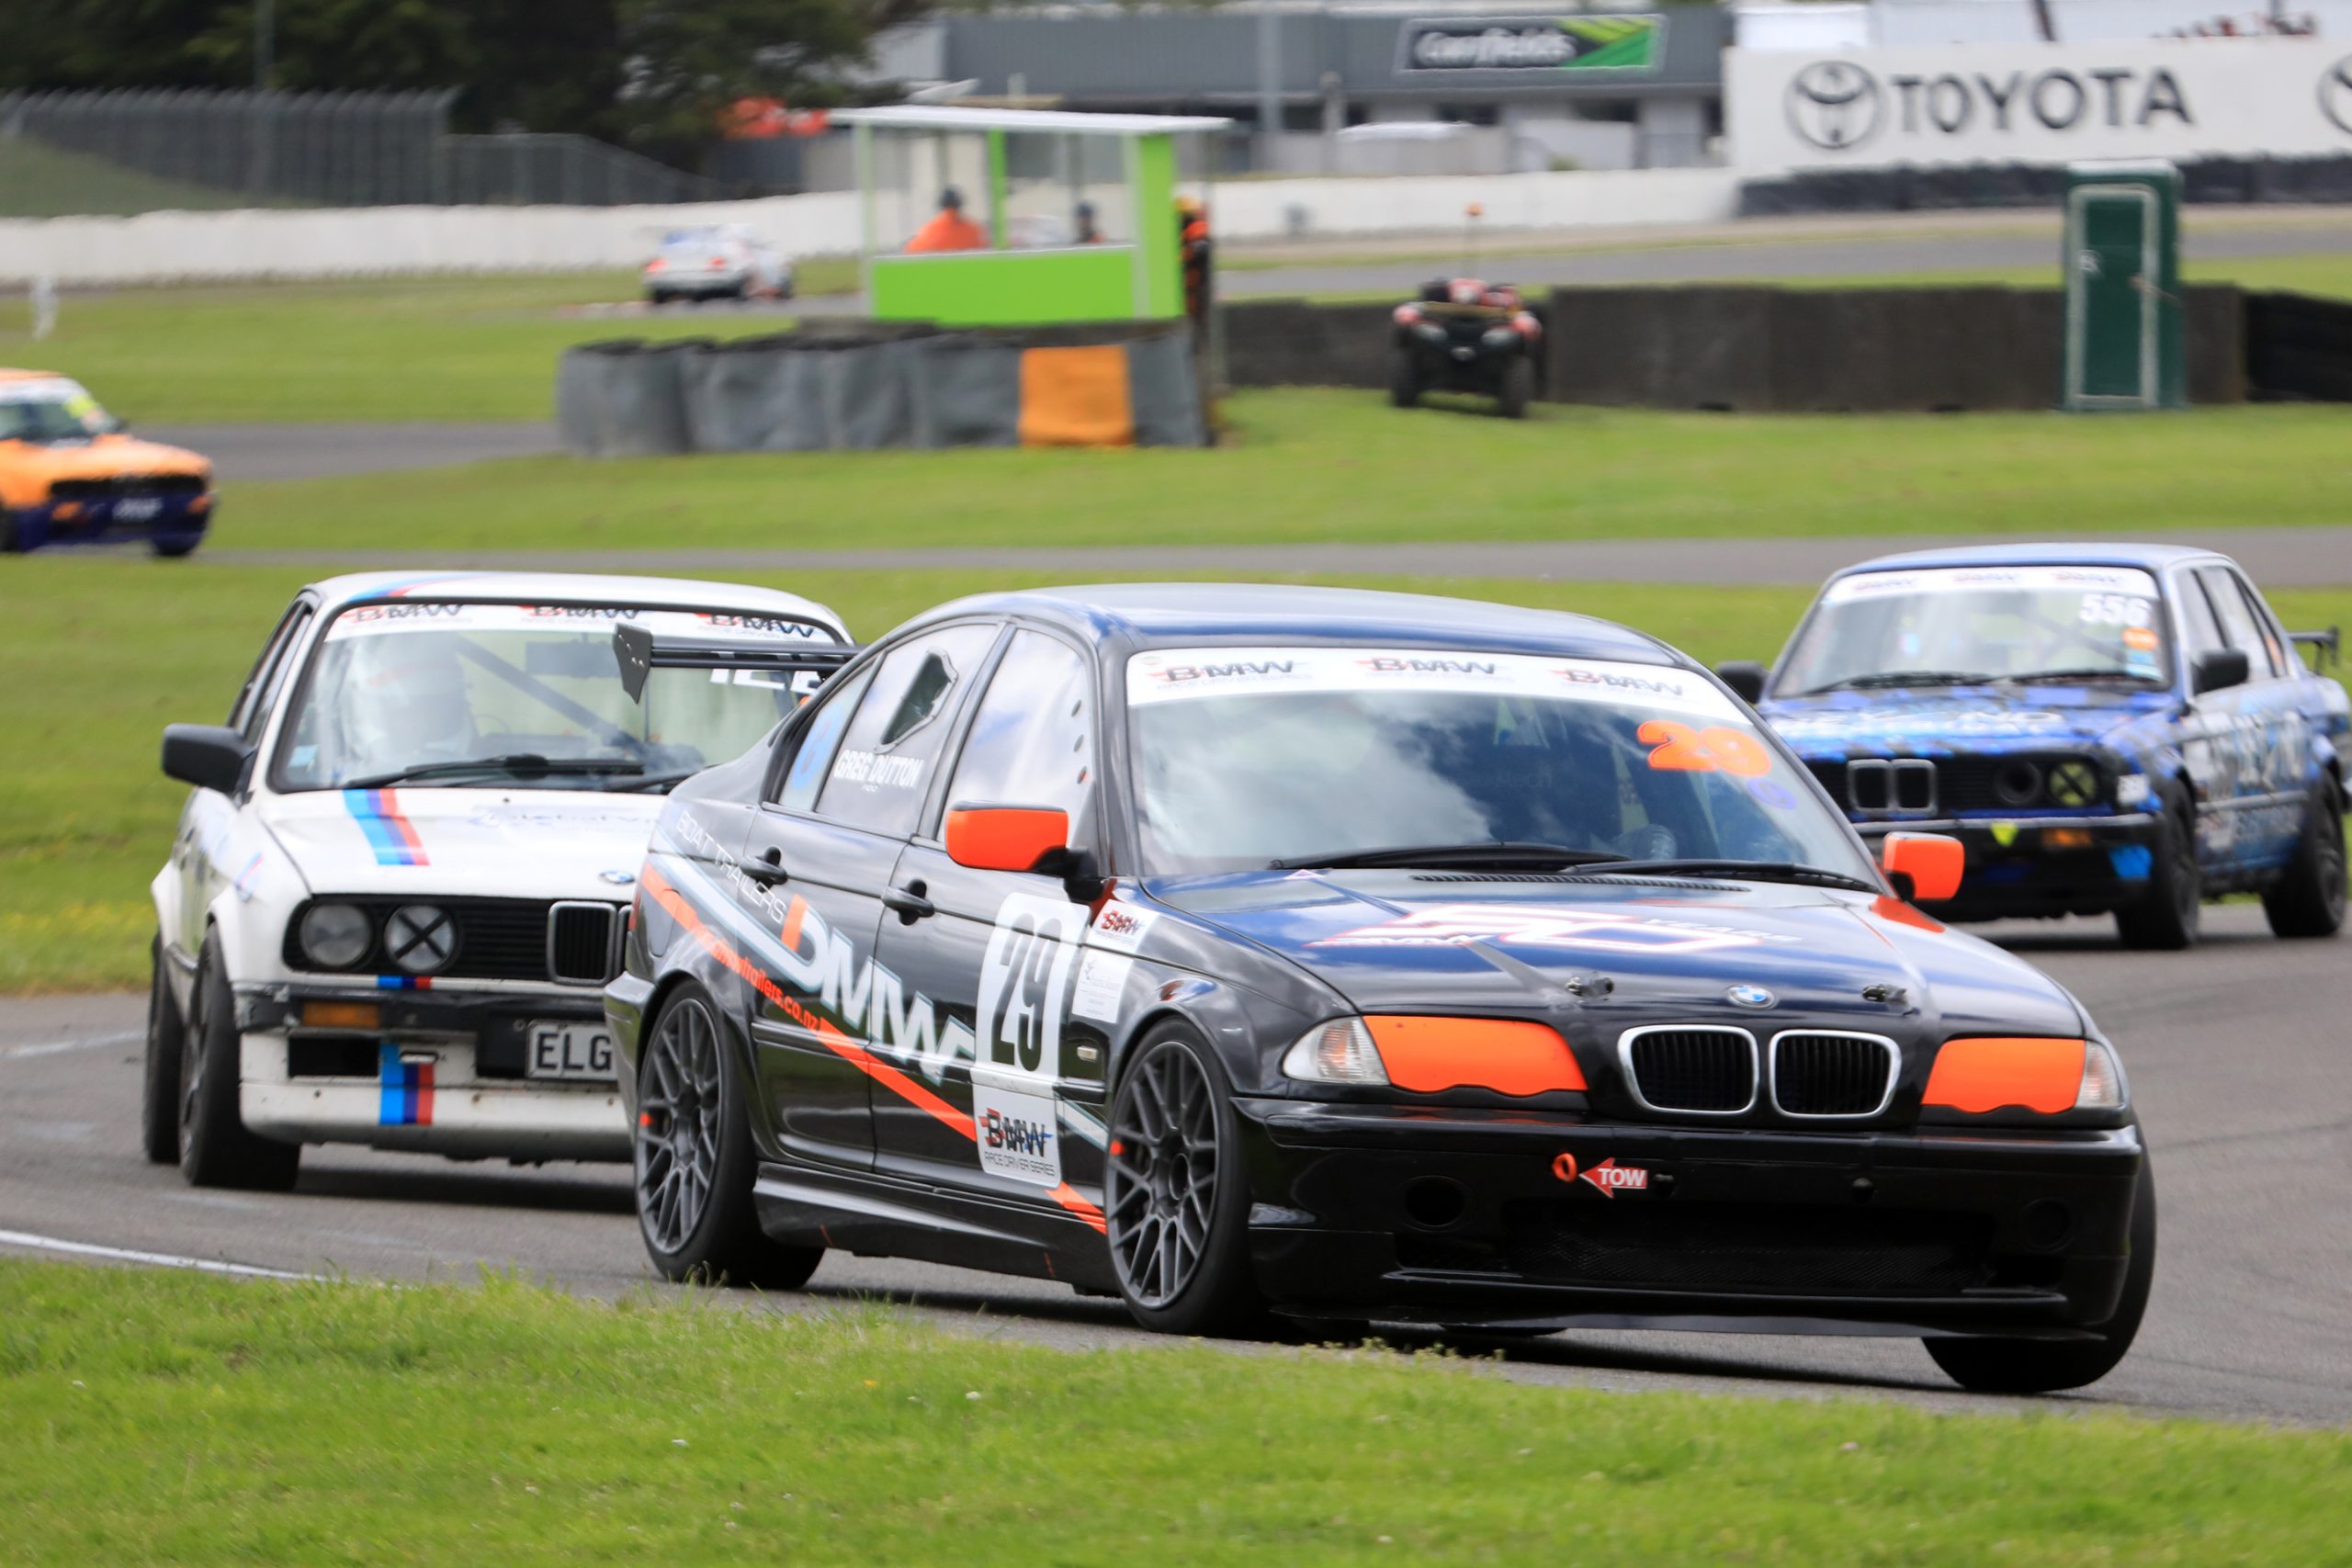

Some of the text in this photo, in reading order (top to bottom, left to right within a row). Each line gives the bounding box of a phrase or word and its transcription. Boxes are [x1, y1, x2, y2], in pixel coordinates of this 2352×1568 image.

[1888, 68, 2194, 134] TOYOTA
[711, 615, 815, 637] BMW
[2079, 593, 2152, 626] 556
[1166, 660, 1294, 682] BMW
[1373, 658, 1495, 675] BMW
[1566, 668, 1684, 696] BMW
[833, 749, 924, 788] GREG DUTTON
[676, 810, 787, 925] BOAT TRAILERS
[991, 913, 1061, 1072] 29
[537, 1032, 613, 1071] ELG
[986, 1111, 1046, 1157] BMW
[1598, 1168, 1646, 1187] TOW
